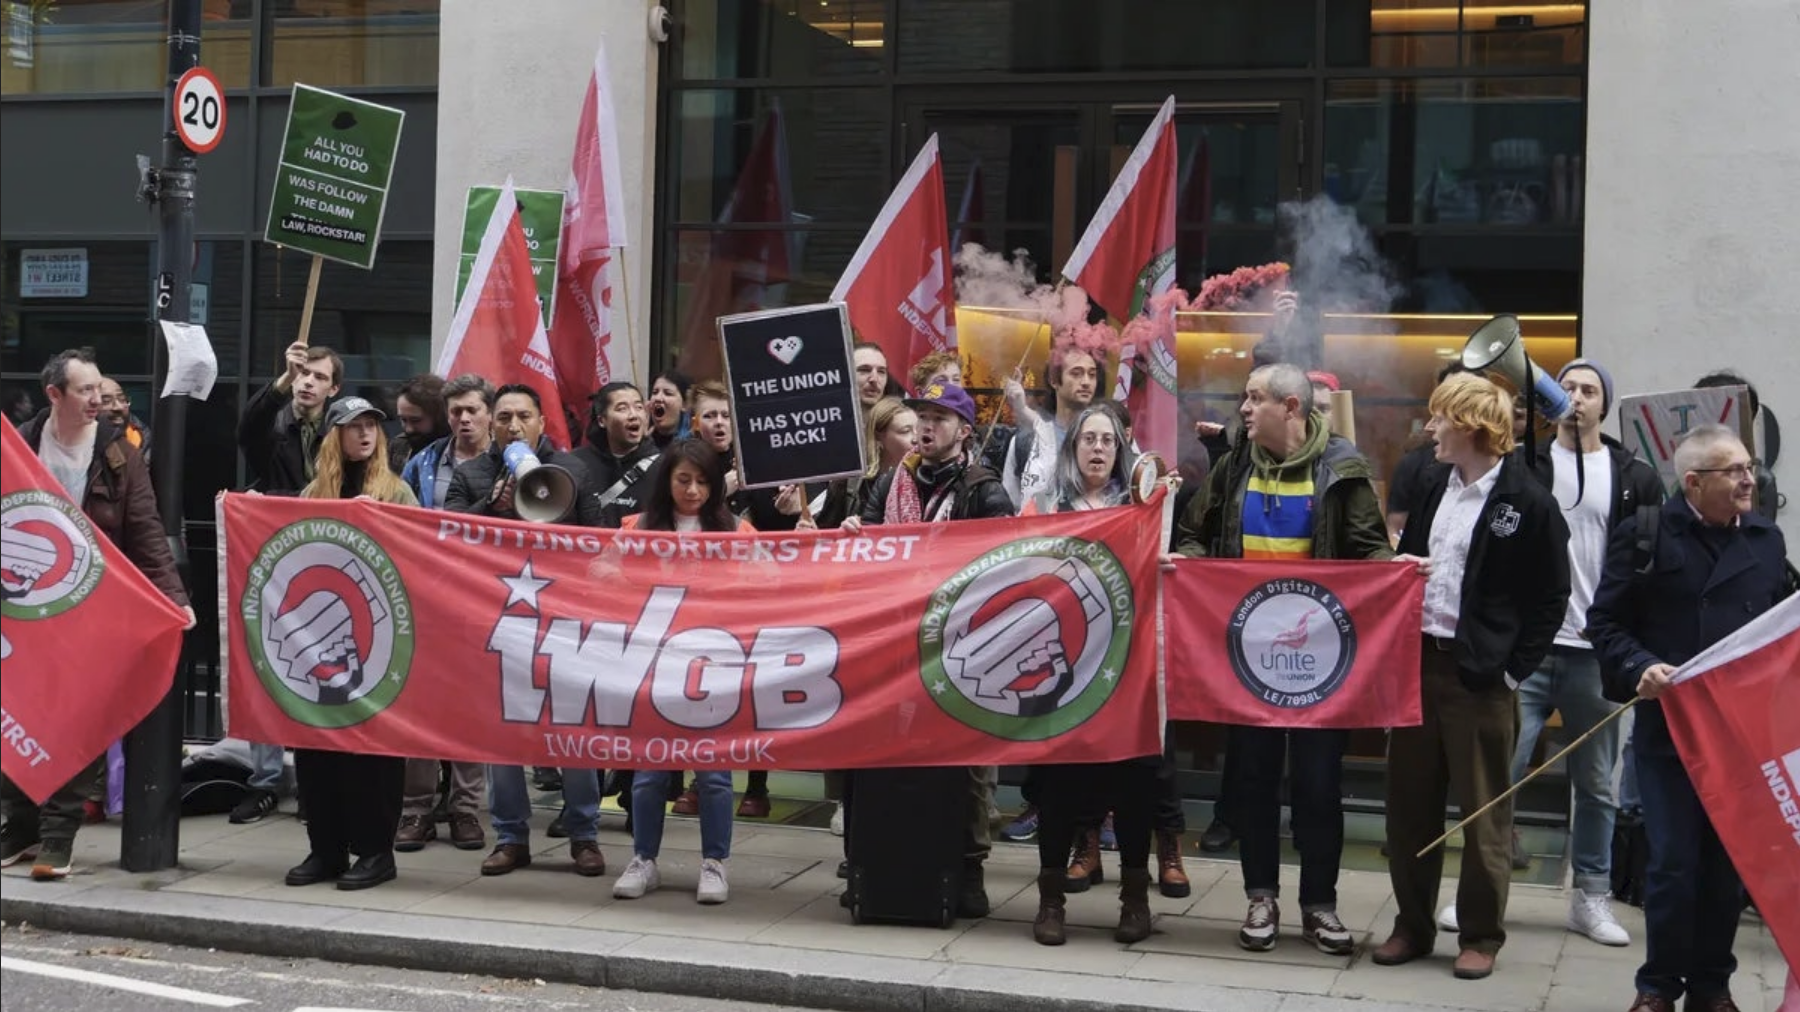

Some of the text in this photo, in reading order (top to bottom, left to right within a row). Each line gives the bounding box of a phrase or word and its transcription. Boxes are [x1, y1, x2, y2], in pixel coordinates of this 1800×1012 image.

[183, 91, 218, 130] 20
[304, 148, 369, 174] HAD TO DO
[314, 136, 364, 158] ALL YOU
[289, 174, 368, 204] WAS FOLLOW
[293, 194, 317, 210] THE
[318, 201, 355, 220] DAMN
[281, 219, 306, 234] LAW,
[307, 224, 367, 243] ROCKSTAR!
[741, 369, 841, 397] THE UNION
[749, 407, 842, 433] HAS YOUR
[769, 427, 827, 448] BACK!
[437, 519, 920, 562] PUTTING WORKERS FIRST
[244, 522, 410, 635] INDEPENDENT WORKERS UNION
[924, 547, 1013, 643] INDEPENDENT
[1100, 557, 1130, 627] UNION
[1233, 590, 1263, 627] London
[1266, 580, 1317, 596] Digital
[1331, 604, 1351, 633] Tech
[1, 707, 51, 768] IRST
[543, 733, 776, 763] IWGB.ORG.UK
